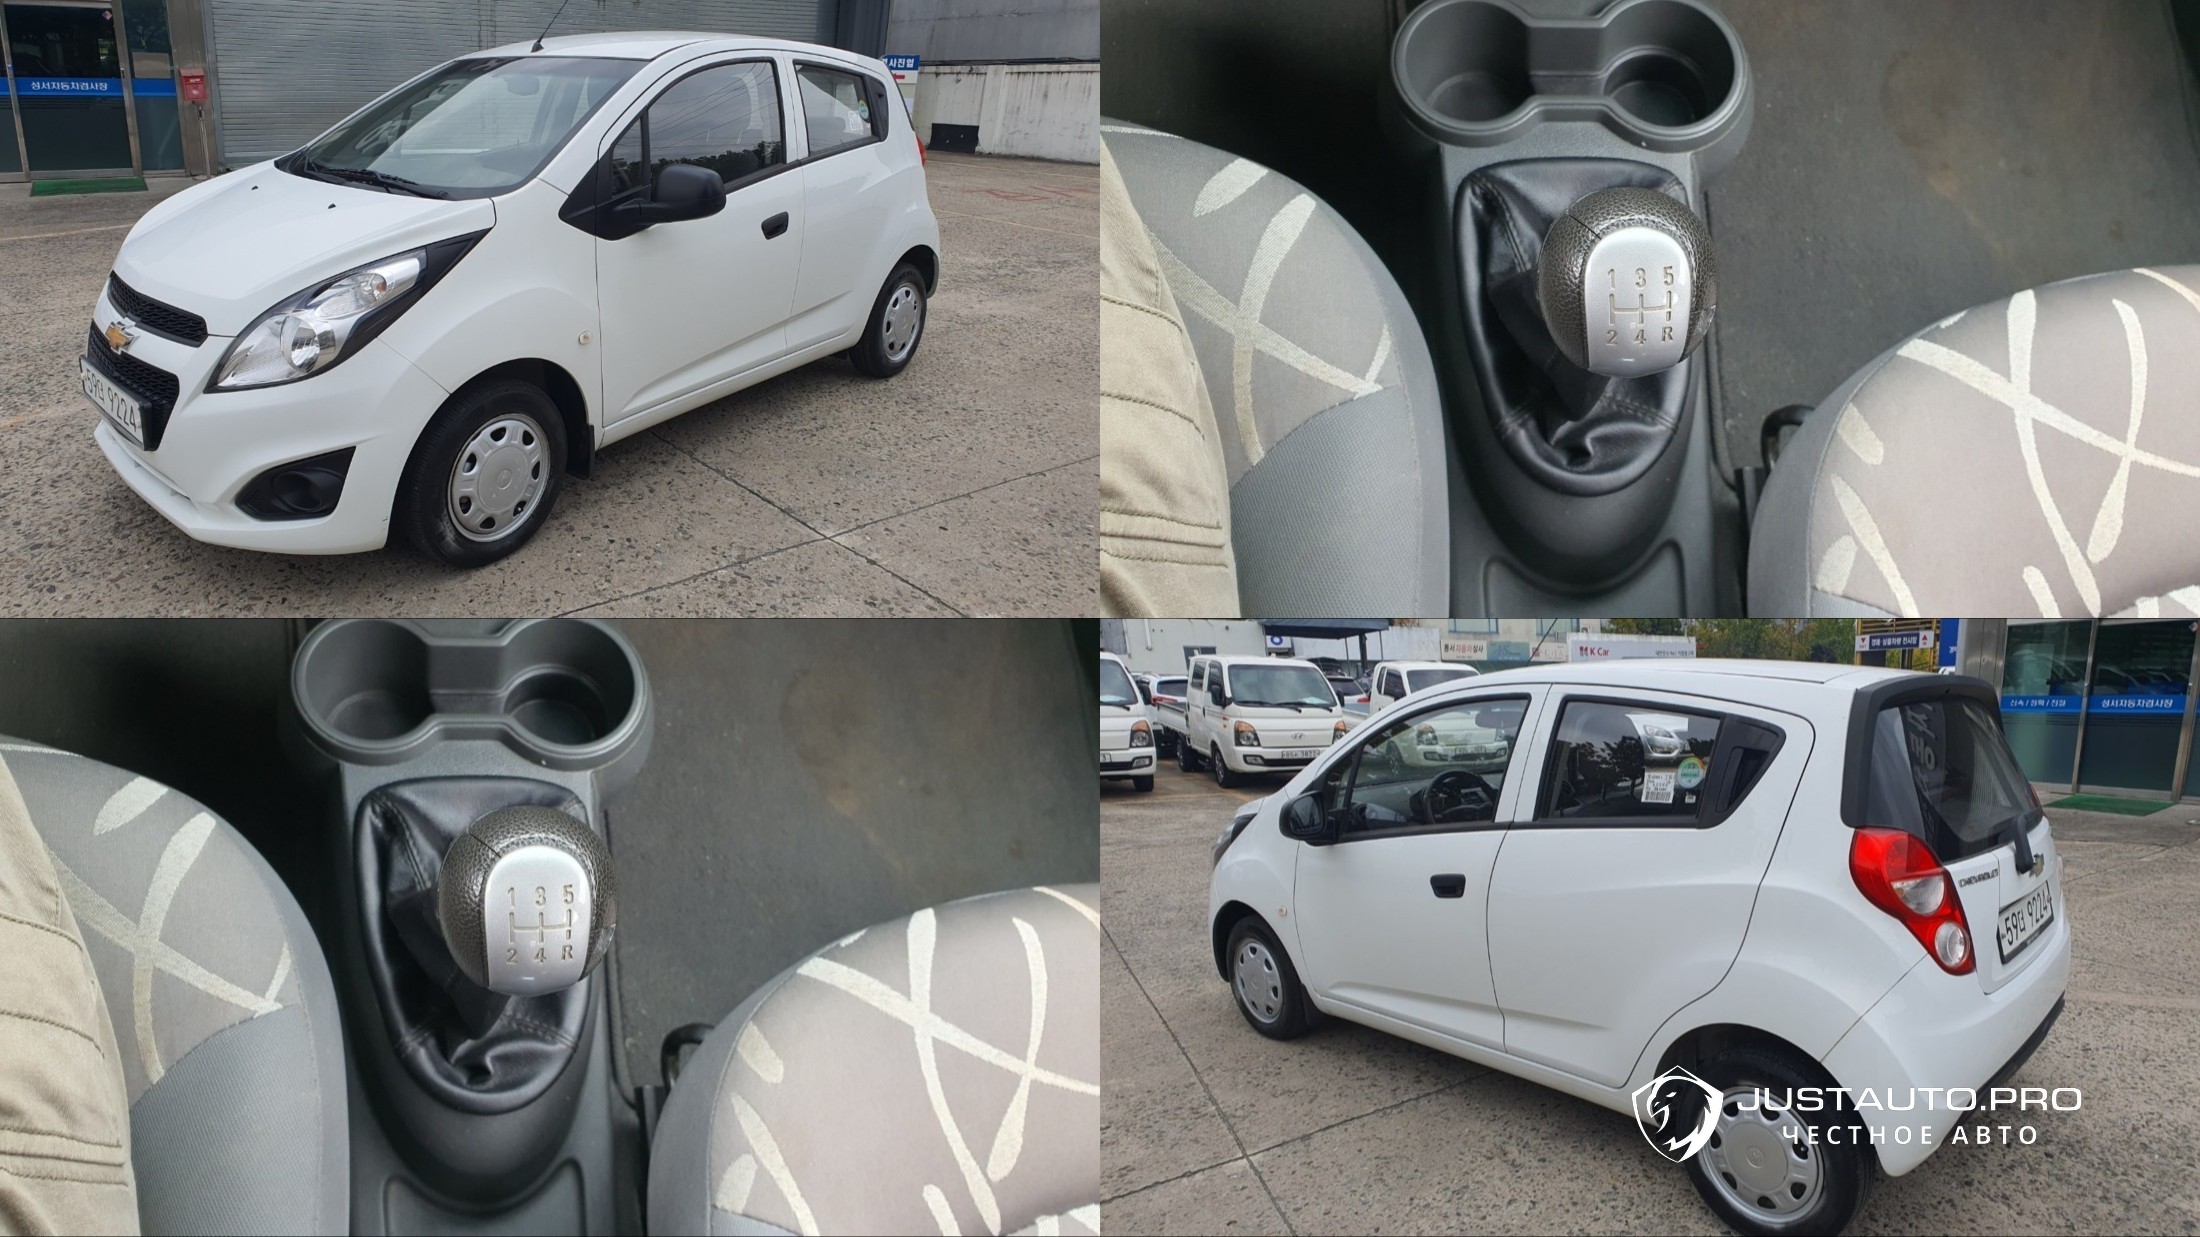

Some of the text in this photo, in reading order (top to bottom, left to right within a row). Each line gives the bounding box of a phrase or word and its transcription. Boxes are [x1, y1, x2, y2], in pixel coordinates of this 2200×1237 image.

[31, 81, 108, 91] 성서자동차검사장
[1607, 265, 1674, 289] 1 3 5
[1606, 326, 1674, 345] 2 4 R
[107, 386, 137, 432] 9224
[1589, 646, 1609, 656] K Car
[2101, 698, 2173, 708] 성서자동차검사장
[507, 884, 574, 908] 1 3 5
[2026, 890, 2048, 928] 9224
[506, 944, 574, 964] 2 4 R
